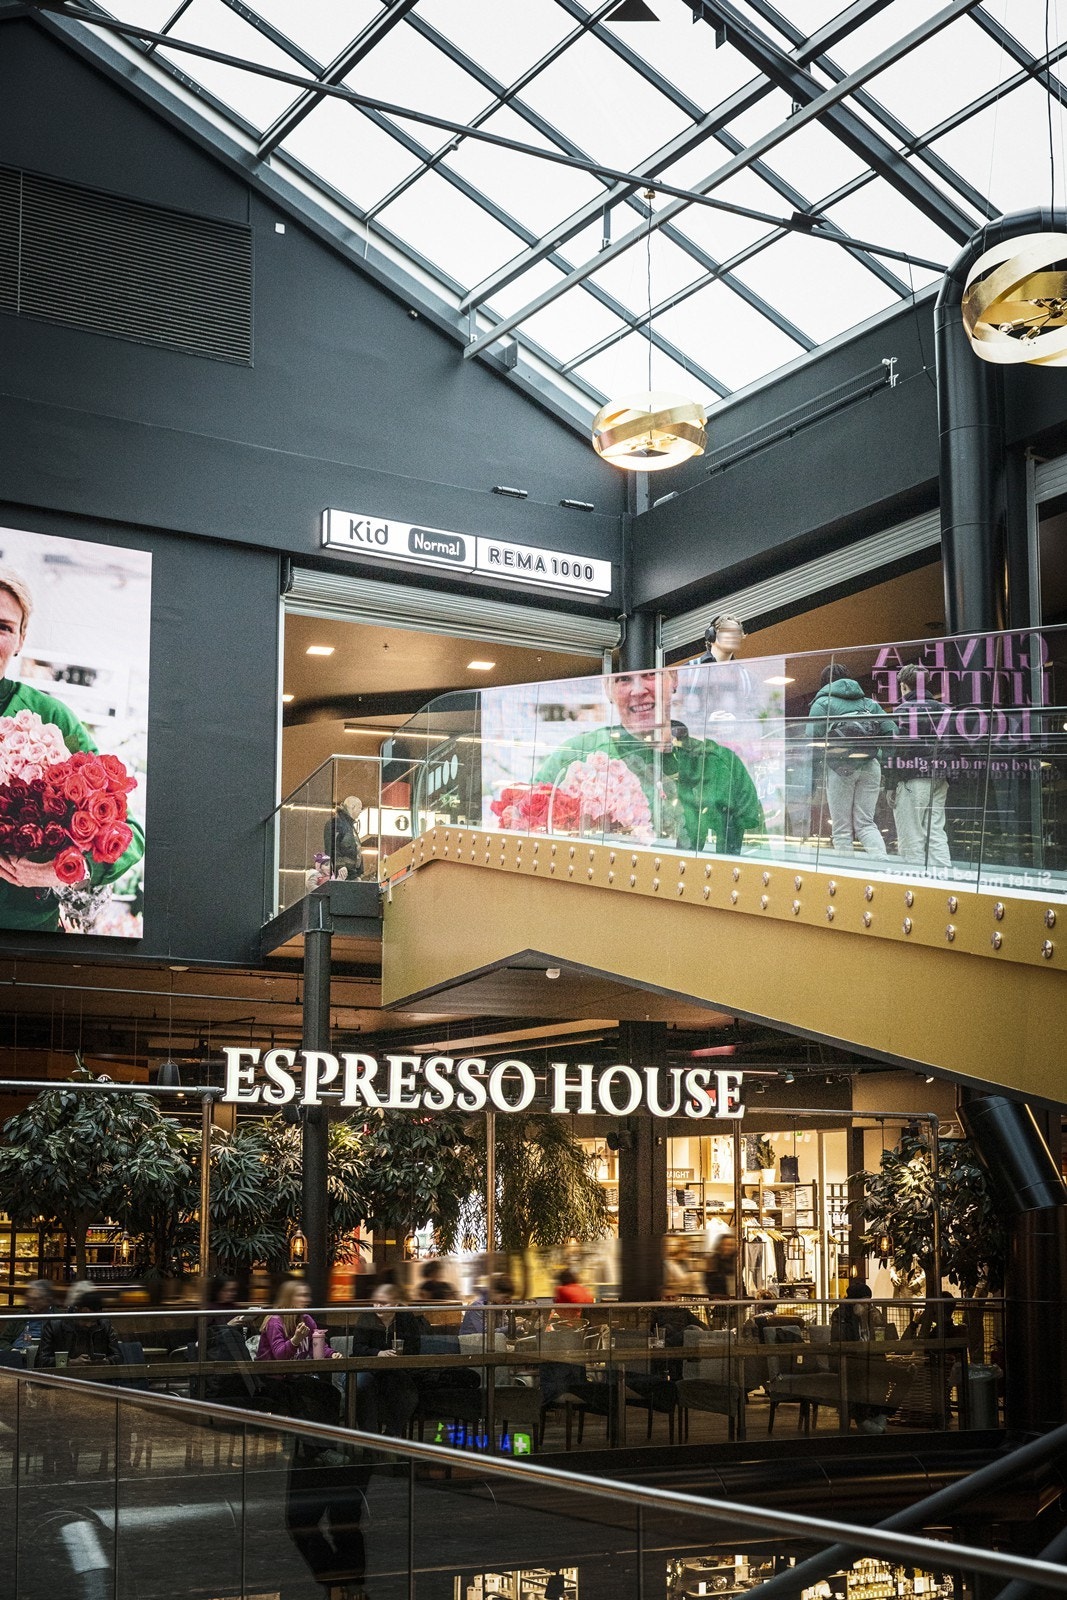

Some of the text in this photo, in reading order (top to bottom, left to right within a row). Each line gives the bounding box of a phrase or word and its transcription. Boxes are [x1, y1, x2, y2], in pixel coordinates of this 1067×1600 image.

[349, 519, 388, 545] Kid
[414, 533, 460, 556] Normal
[489, 547, 593, 580] REMA 1000
[220, 1047, 746, 1119] ESPRESSO HOUSE
